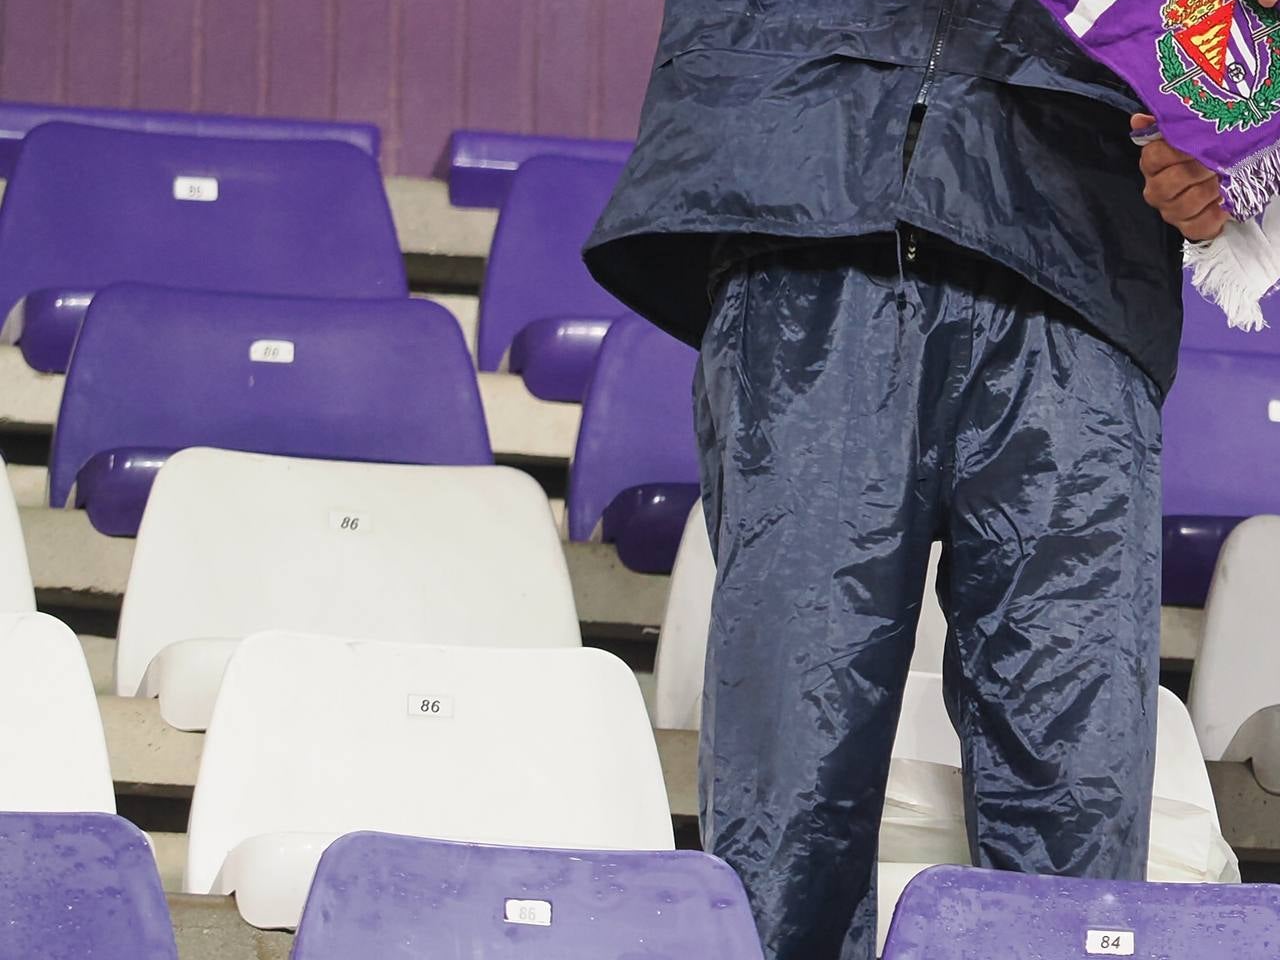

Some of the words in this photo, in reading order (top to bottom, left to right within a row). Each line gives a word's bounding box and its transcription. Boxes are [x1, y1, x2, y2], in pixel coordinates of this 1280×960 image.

[340, 516, 360, 530] 86
[420, 699, 441, 713] 86
[518, 905, 537, 921] 86
[1099, 935, 1121, 949] 84
